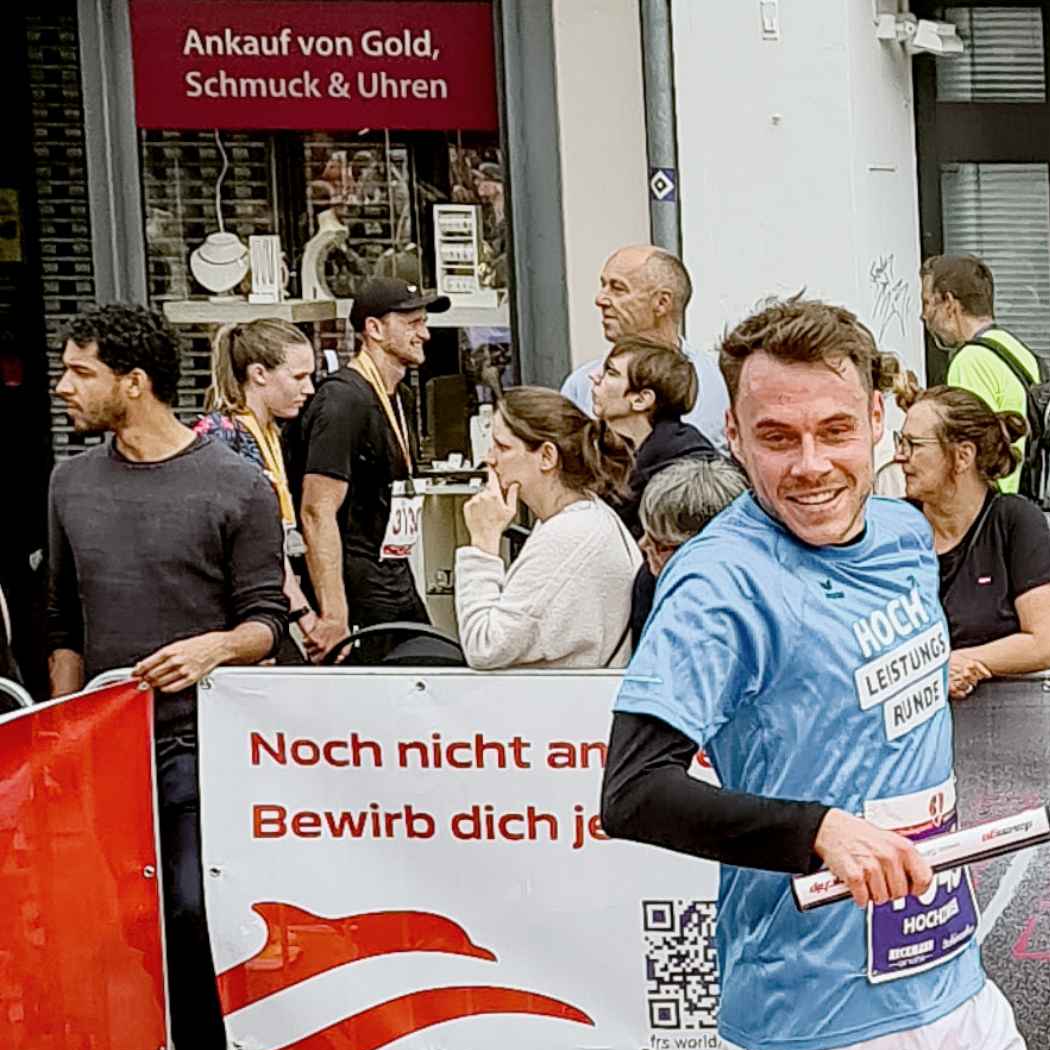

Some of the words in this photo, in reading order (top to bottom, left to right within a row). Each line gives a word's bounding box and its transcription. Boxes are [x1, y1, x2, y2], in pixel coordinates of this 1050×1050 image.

[183, 28, 292, 56] Ankauf
[297, 35, 353, 57] von
[360, 29, 440, 61] Gold,
[185, 70, 321, 98] Schmuck
[327, 72, 351, 98] &
[357, 72, 448, 99] Uhren
[852, 584, 930, 658] HOCH
[865, 632, 946, 696] LEISTUNGS
[893, 679, 939, 727] RUNDE
[249, 732, 382, 767] Noch
[399, 733, 530, 769] nicht
[546, 741, 609, 769] an
[252, 803, 436, 840] Bewirb
[450, 804, 558, 841] dich
[572, 804, 610, 849] je
